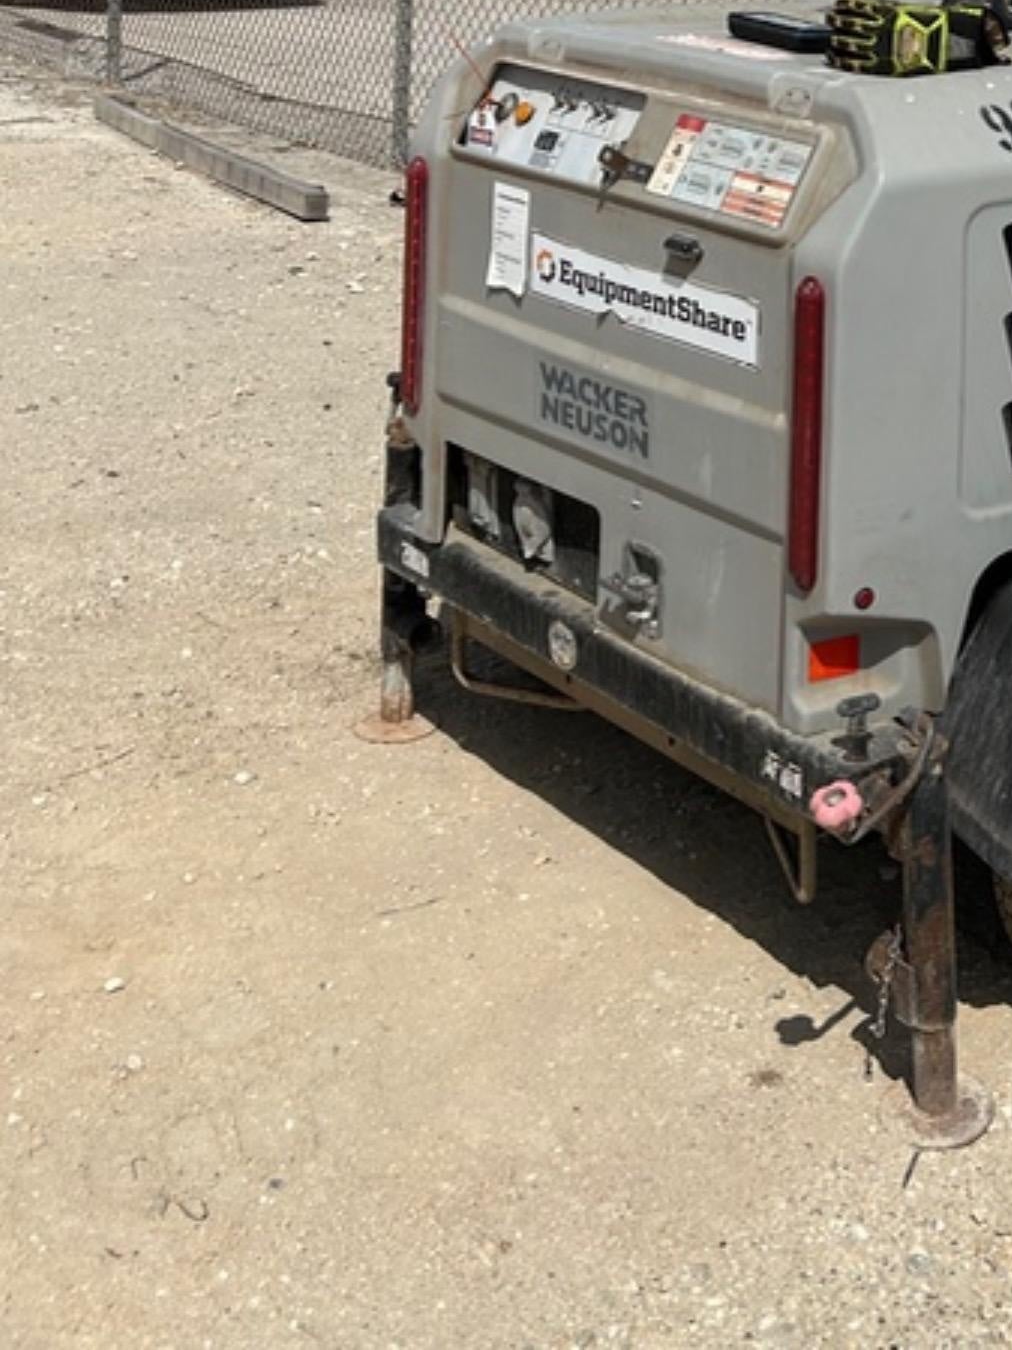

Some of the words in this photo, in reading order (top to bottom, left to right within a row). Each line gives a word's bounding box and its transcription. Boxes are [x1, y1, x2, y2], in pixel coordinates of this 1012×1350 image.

[559, 258, 747, 341] EquipmentShare
[540, 362, 648, 427] WACKER
[541, 393, 649, 459] NEUSON
